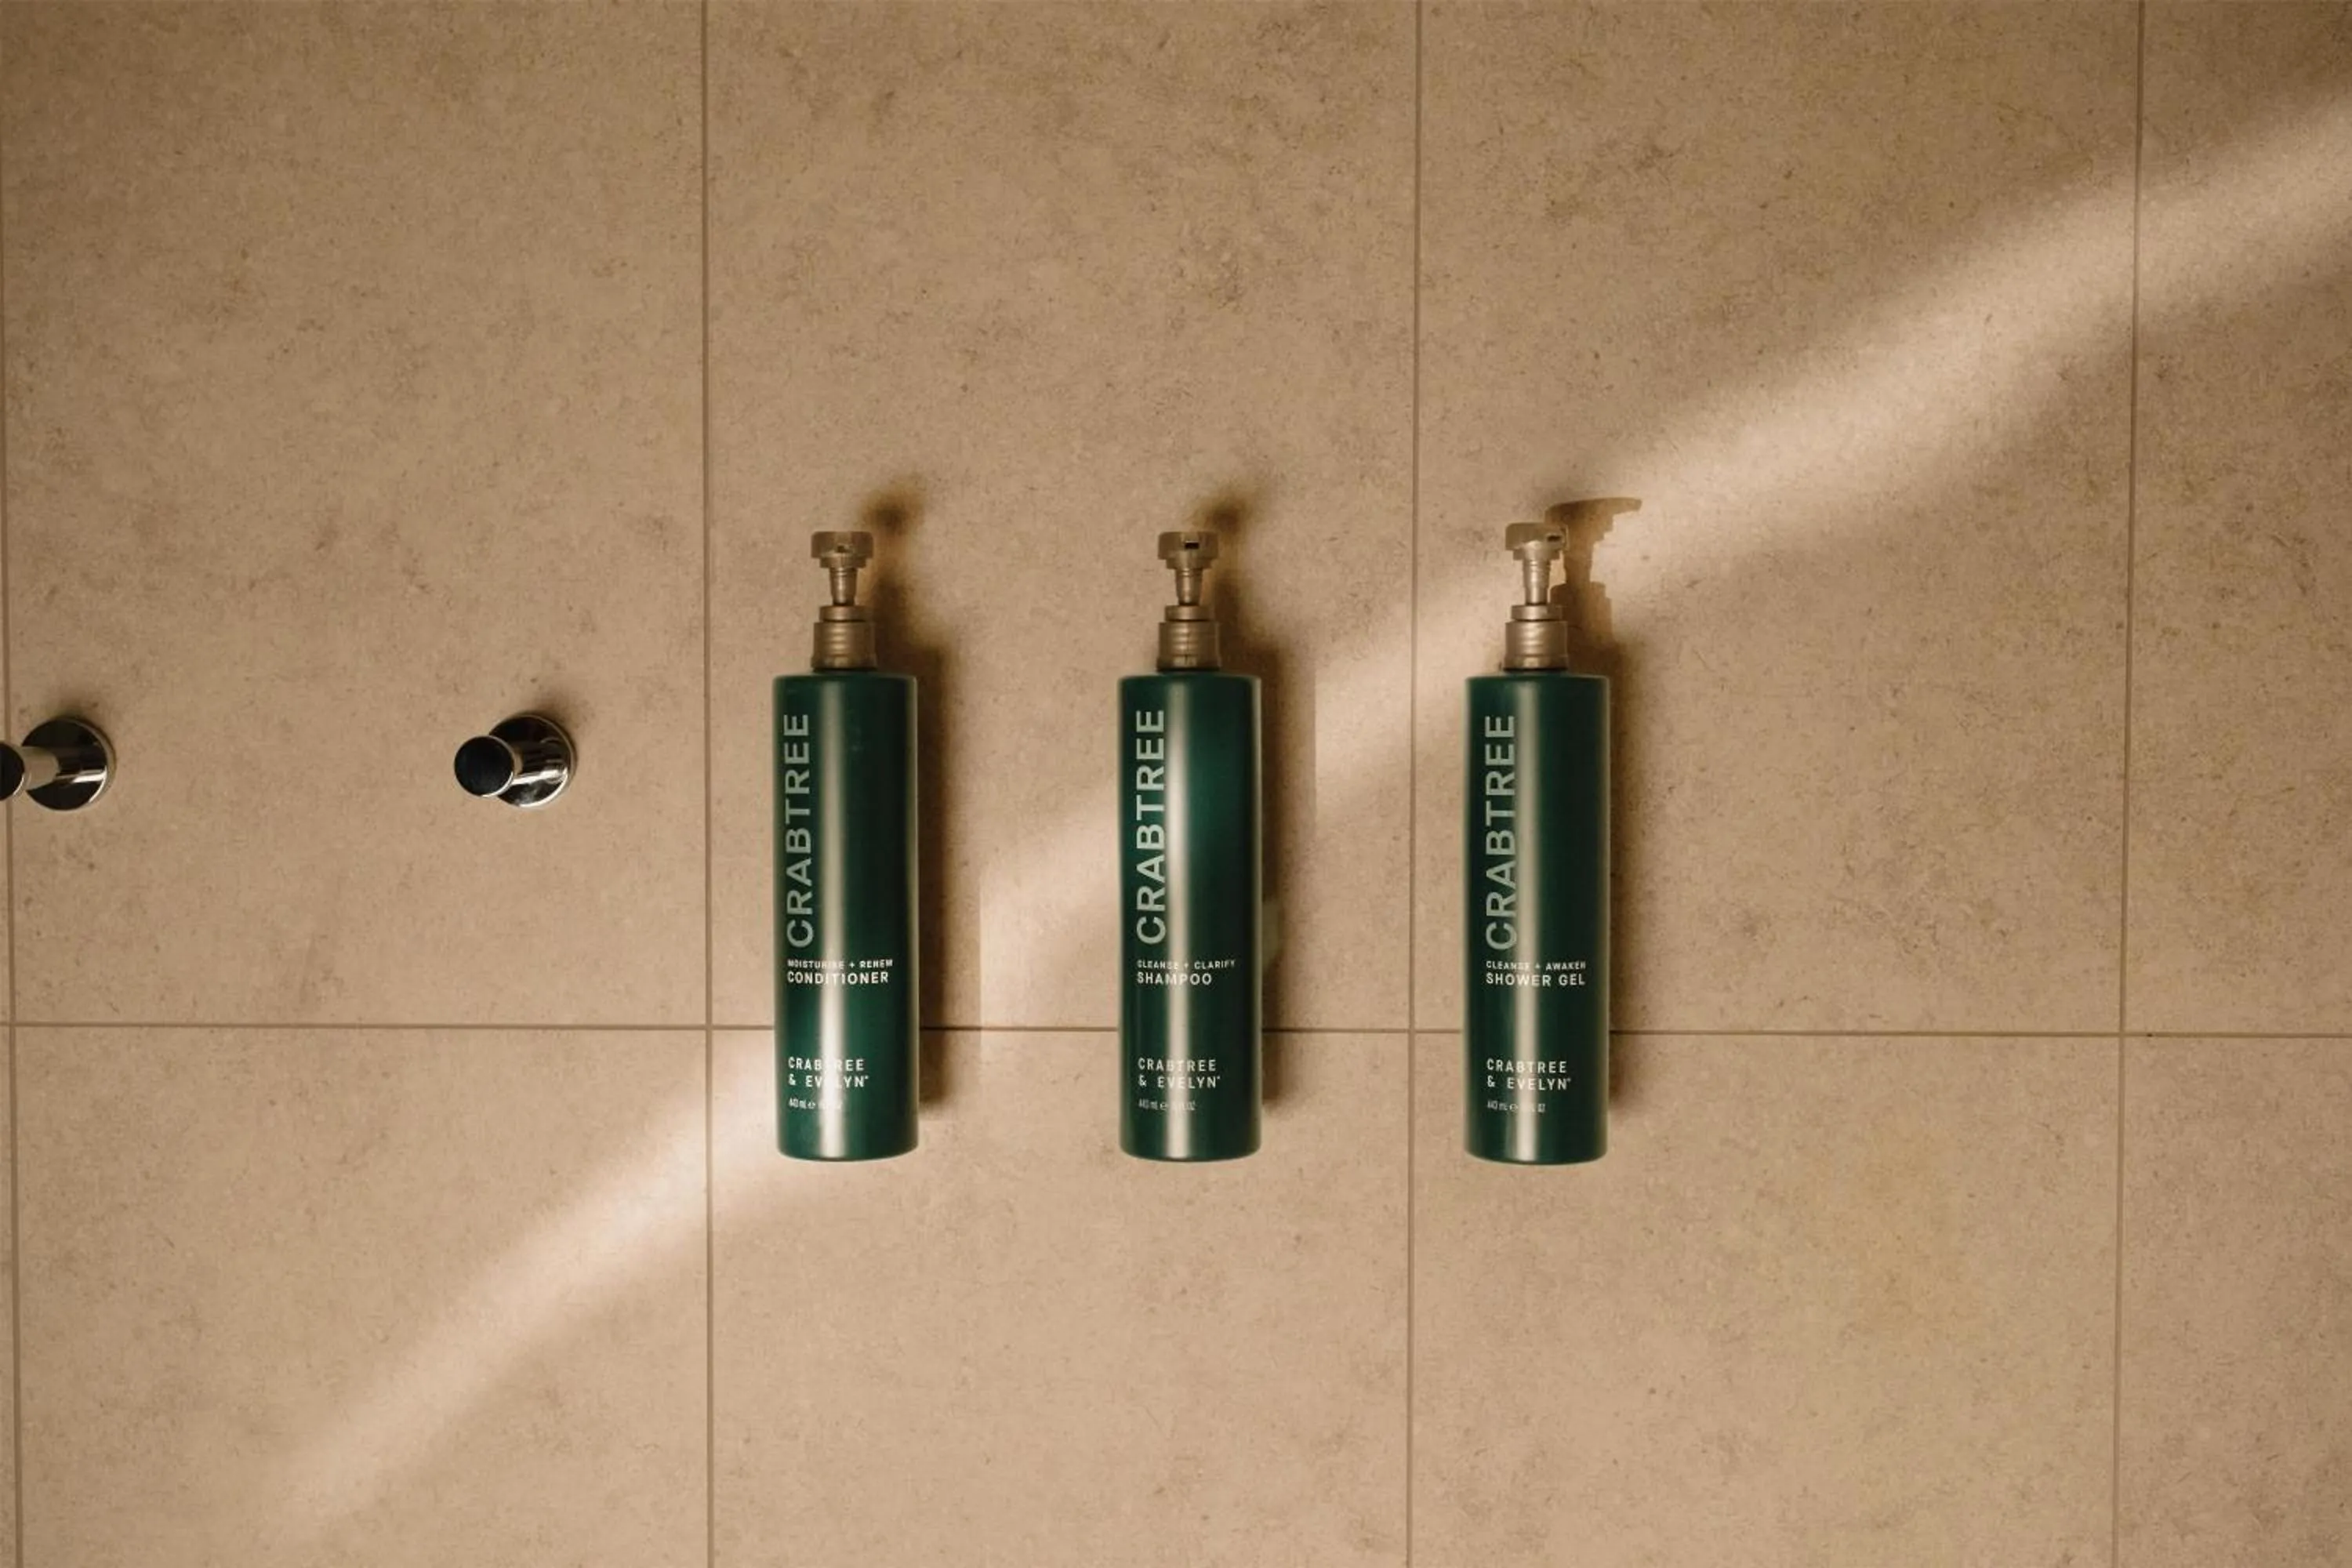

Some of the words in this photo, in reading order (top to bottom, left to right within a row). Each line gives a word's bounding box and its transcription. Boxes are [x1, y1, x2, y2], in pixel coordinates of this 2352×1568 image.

[784, 714, 813, 948] CRABTREE
[1137, 710, 1166, 944] CRABTREE
[1485, 716, 1516, 950] CRABTREE
[787, 959, 844, 969] MOISTURE
[1194, 959, 1236, 970] CLARIFY
[1545, 960, 1586, 971] AWAKEN
[787, 970, 888, 985] CONDITIONER
[1137, 971, 1212, 985] SHAMPOO
[1486, 972, 1552, 987] SHOWER
[1559, 974, 1586, 986] GEL
[788, 1056, 865, 1071] CRABREE
[1138, 1057, 1216, 1072] CRABTREE
[1486, 1058, 1567, 1073] CRABTREE
[789, 1073, 797, 1086] &
[805, 1075, 865, 1087] EVYN
[1138, 1074, 1147, 1087] &
[1487, 1075, 1496, 1087] &
